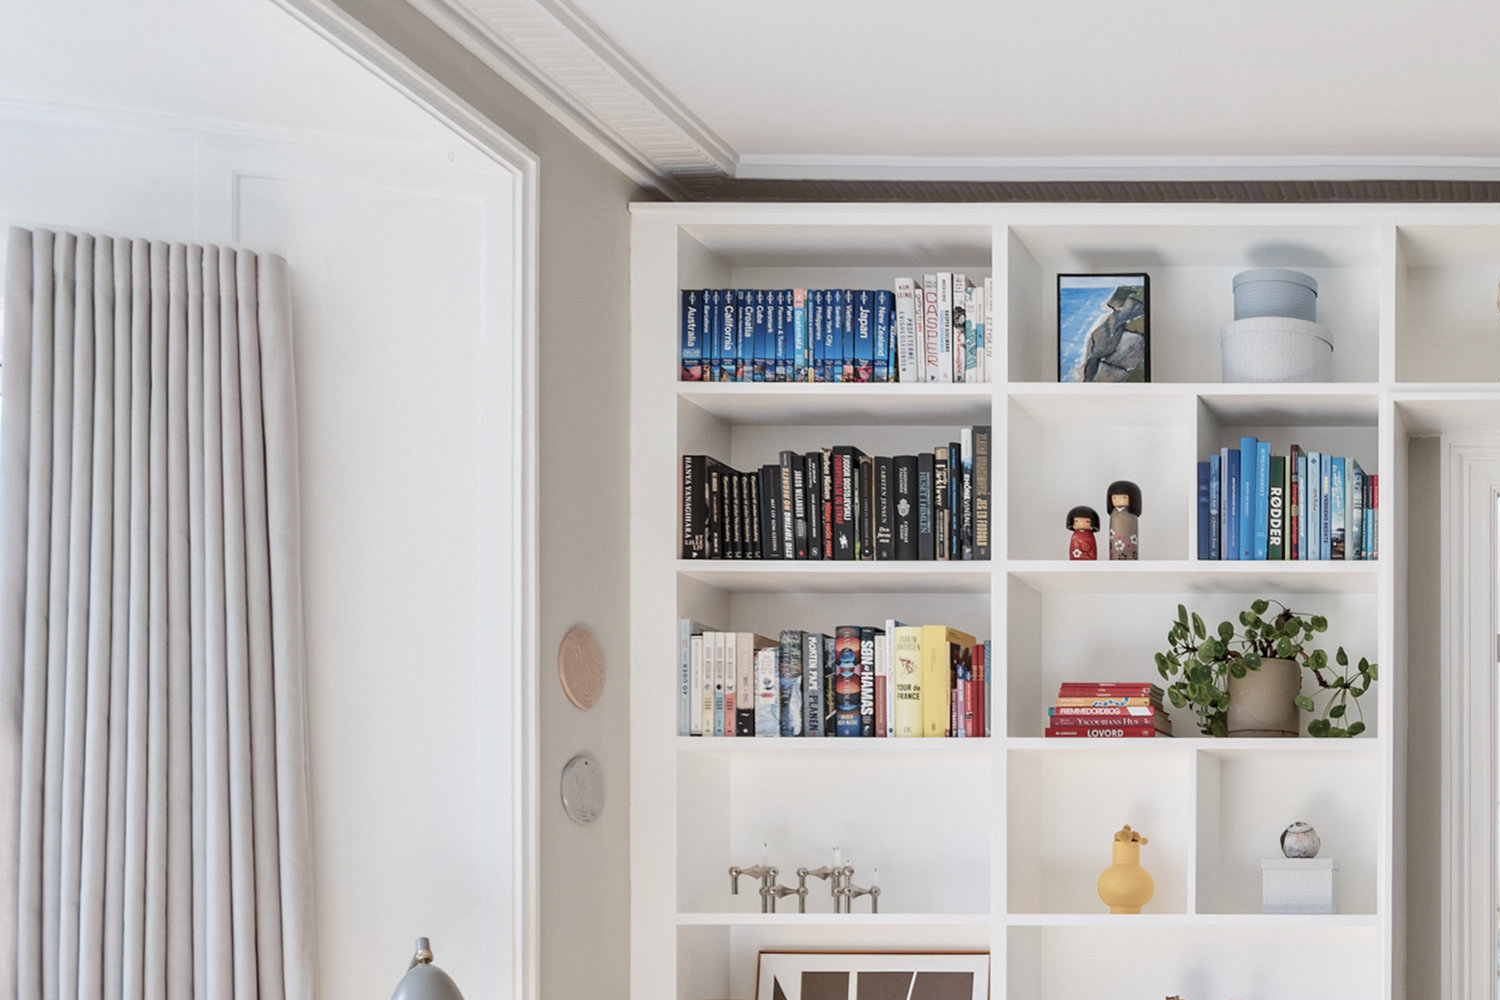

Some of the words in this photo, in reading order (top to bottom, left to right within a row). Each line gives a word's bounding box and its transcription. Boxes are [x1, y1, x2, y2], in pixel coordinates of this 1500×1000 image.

[687, 306, 698, 347] Australia
[724, 305, 734, 351] California
[744, 306, 753, 338] Croatia
[756, 305, 764, 324] Cuba
[858, 306, 870, 338] Japan
[926, 291, 938, 367] CASPER
[795, 310, 803, 349] Guatemala
[878, 325, 886, 357] Zealand
[684, 456, 692, 485] HANYA
[782, 467, 790, 498] REGRETS
[794, 470, 802, 487] JAKOB
[919, 471, 927, 497] HUSET
[684, 485, 692, 539] YANAGIHARA
[783, 500, 790, 511] NO
[795, 488, 804, 517] MELANDER
[835, 496, 843, 504] OG
[976, 498, 988, 510] JEG
[835, 506, 843, 524] STRAF
[919, 503, 927, 533] HIMLEN
[1269, 487, 1282, 546] RØDDER
[976, 519, 988, 546] FODBOLD
[808, 637, 818, 669] MORTEN
[860, 640, 873, 665] SØN
[808, 671, 818, 690] PAPE
[860, 671, 874, 715] HAMAS
[897, 692, 920, 700] FRANCE
[809, 695, 819, 731] PLANEN
[1060, 707, 1120, 715] FREMMEDORDBOG
[1077, 718, 1122, 726] YACOUBIANS
[1123, 718, 1139, 726] HUS
[1087, 729, 1124, 737] LOVORD
